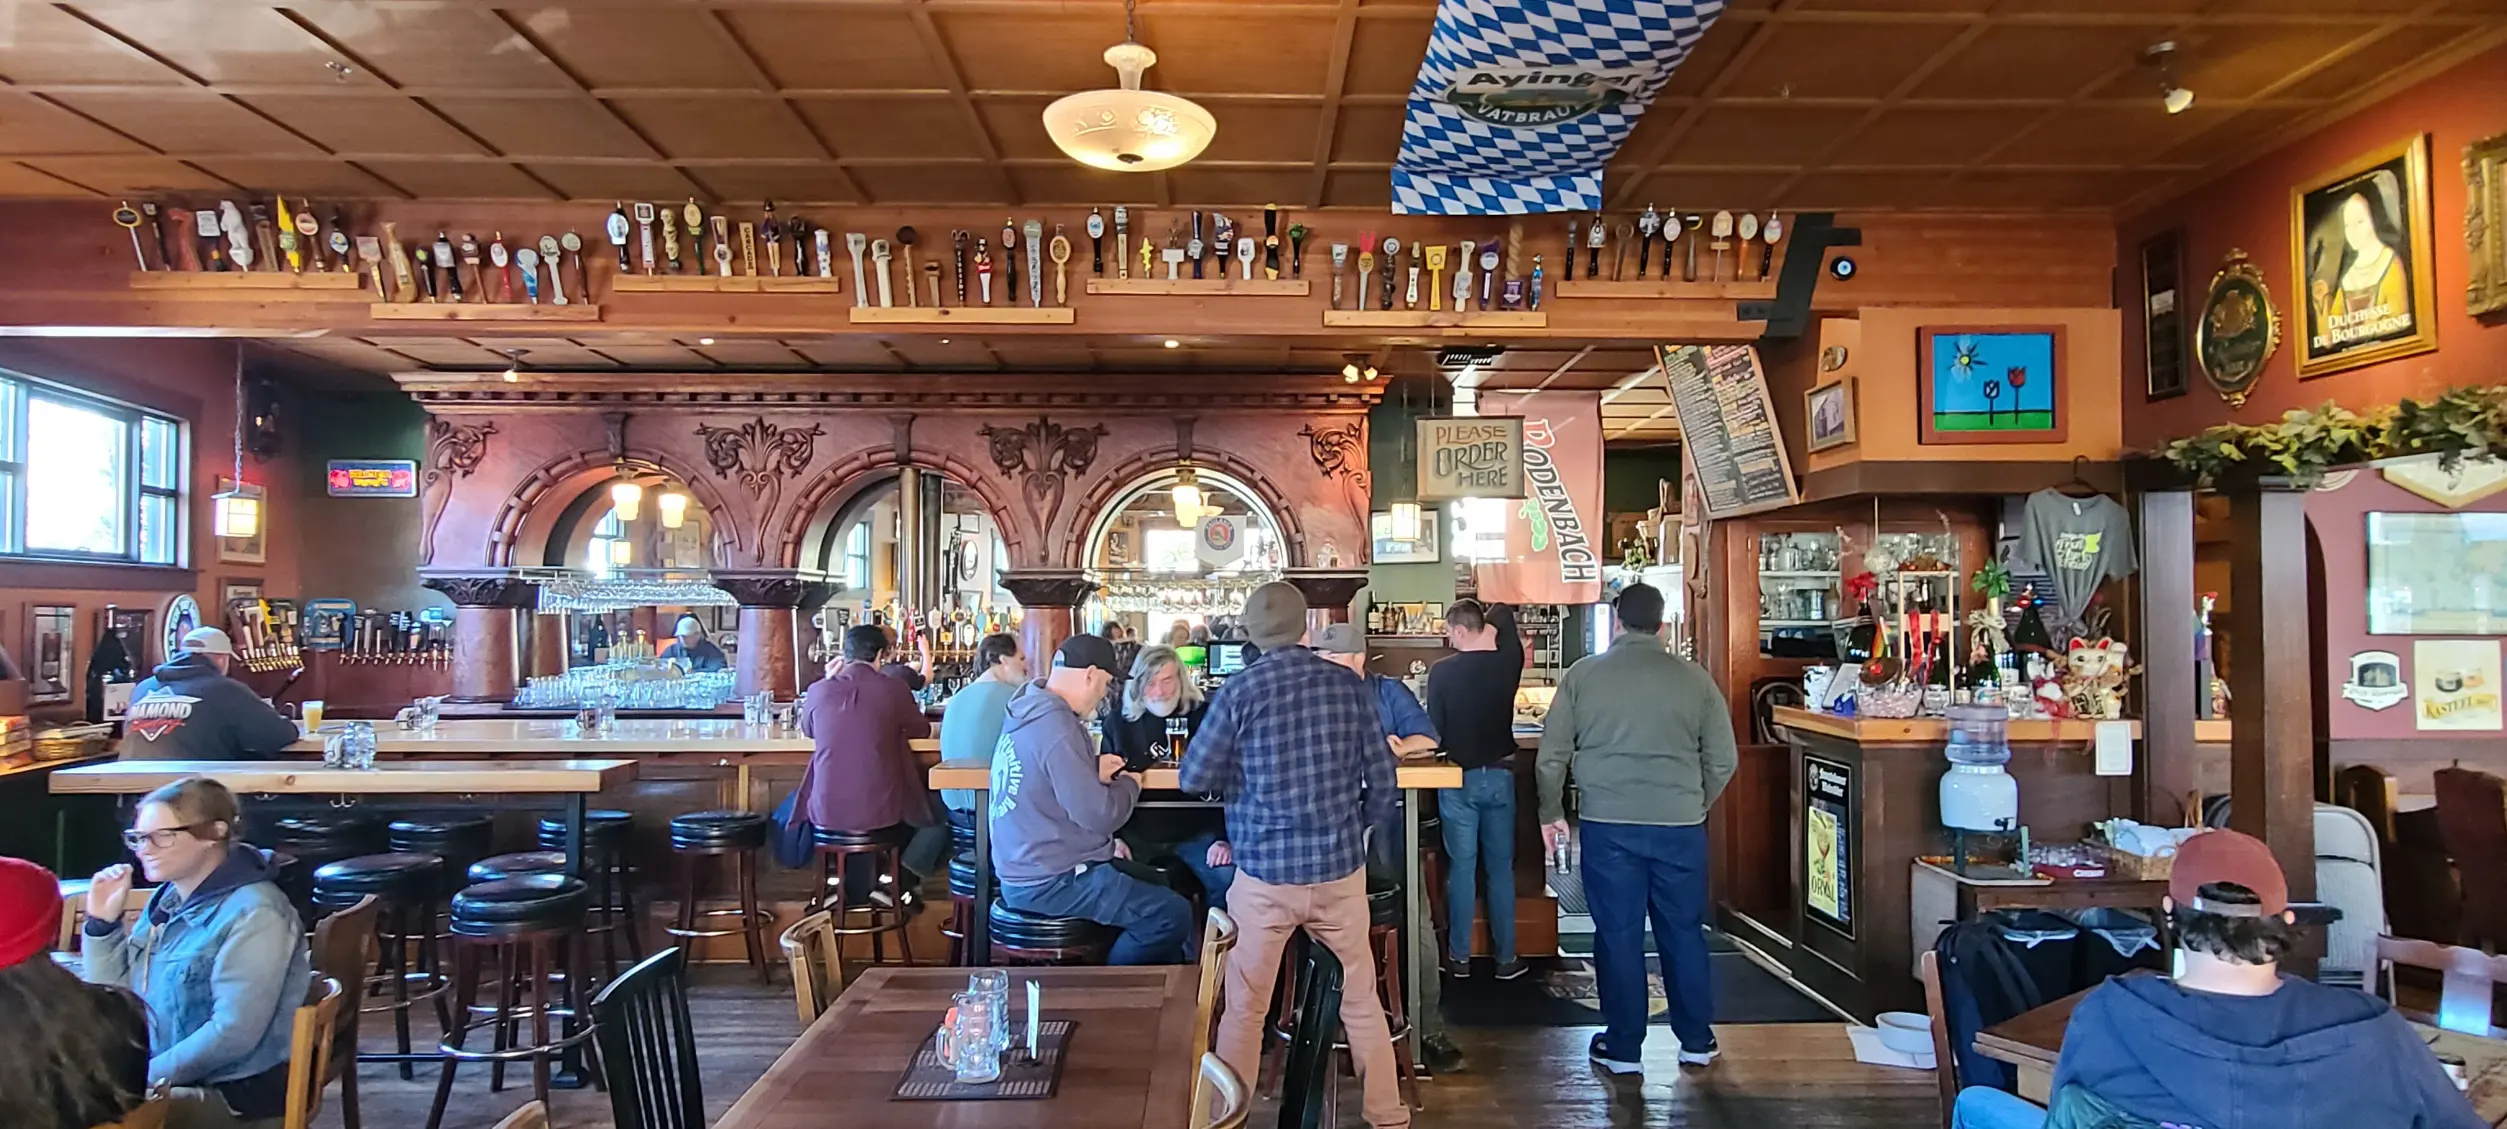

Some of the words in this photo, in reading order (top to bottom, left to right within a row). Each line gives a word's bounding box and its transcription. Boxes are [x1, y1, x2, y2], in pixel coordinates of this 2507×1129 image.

[2331, 313, 2412, 344] BOURGOGNE
[1435, 425, 1508, 446] PLEASE
[1435, 442, 1508, 477] ORDER
[1457, 465, 1508, 487] HERE
